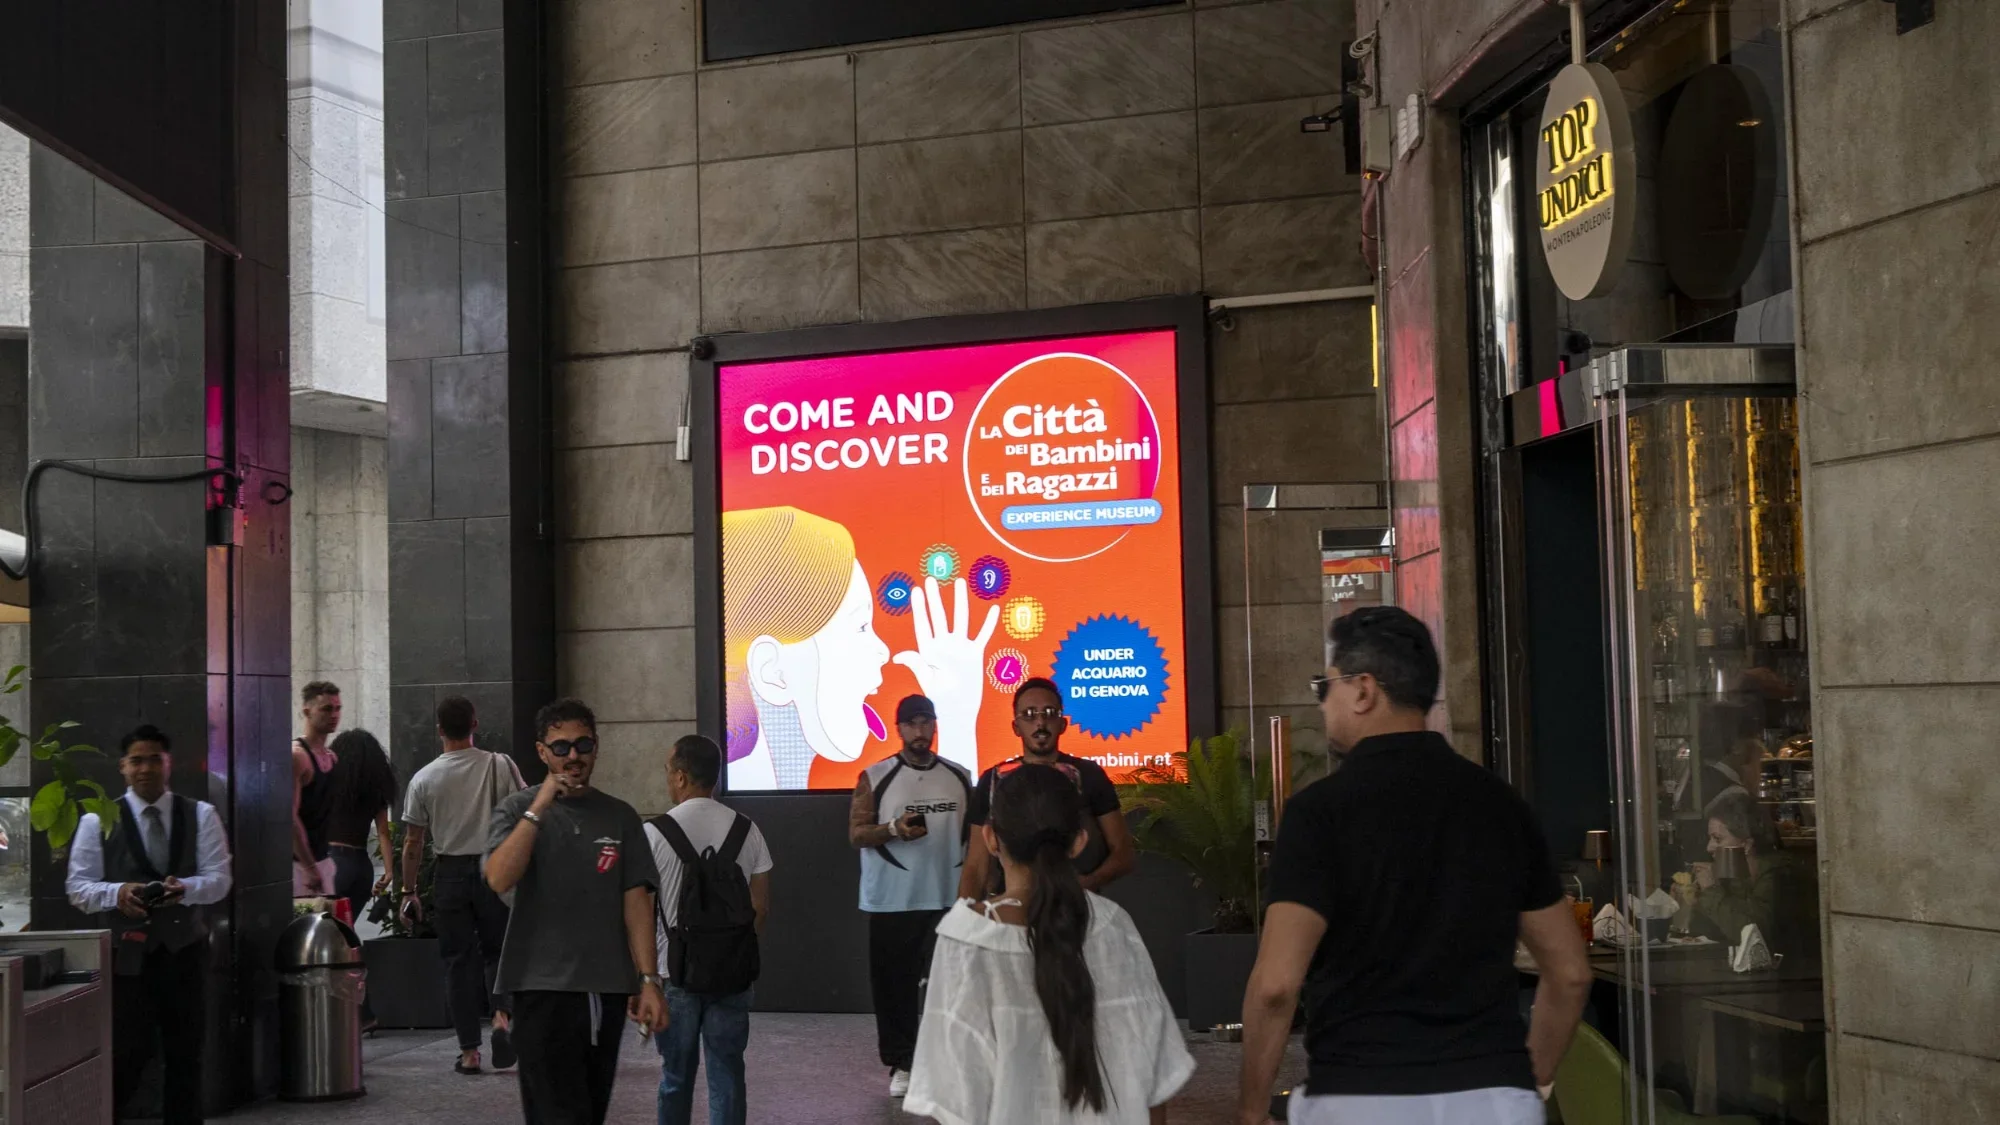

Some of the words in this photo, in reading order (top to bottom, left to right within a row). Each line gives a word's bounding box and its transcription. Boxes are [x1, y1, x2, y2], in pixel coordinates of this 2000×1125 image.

[1541, 99, 1595, 173] TOP
[1537, 153, 1612, 229] UNDICI
[1546, 207, 1612, 253] MONTENAPOLEONE
[743, 397, 855, 434] COME
[867, 390, 954, 426] AND
[979, 426, 1003, 439] LA
[1002, 398, 1107, 437] Città
[751, 432, 949, 475] DISCOVER
[1005, 444, 1028, 456] DEI
[1030, 436, 1151, 466] Bambini
[981, 474, 990, 484] E
[981, 485, 1004, 496] DEI
[1005, 466, 1118, 500] Ragazzi
[1006, 508, 1092, 524] EXPERIENCE
[1095, 506, 1156, 520] MUSEUM
[1084, 648, 1134, 661] UNDER
[1071, 666, 1147, 680] ACQUARIO
[1070, 686, 1086, 698] DI
[1088, 685, 1149, 697] GENOVA
[905, 802, 958, 814] SENSE
